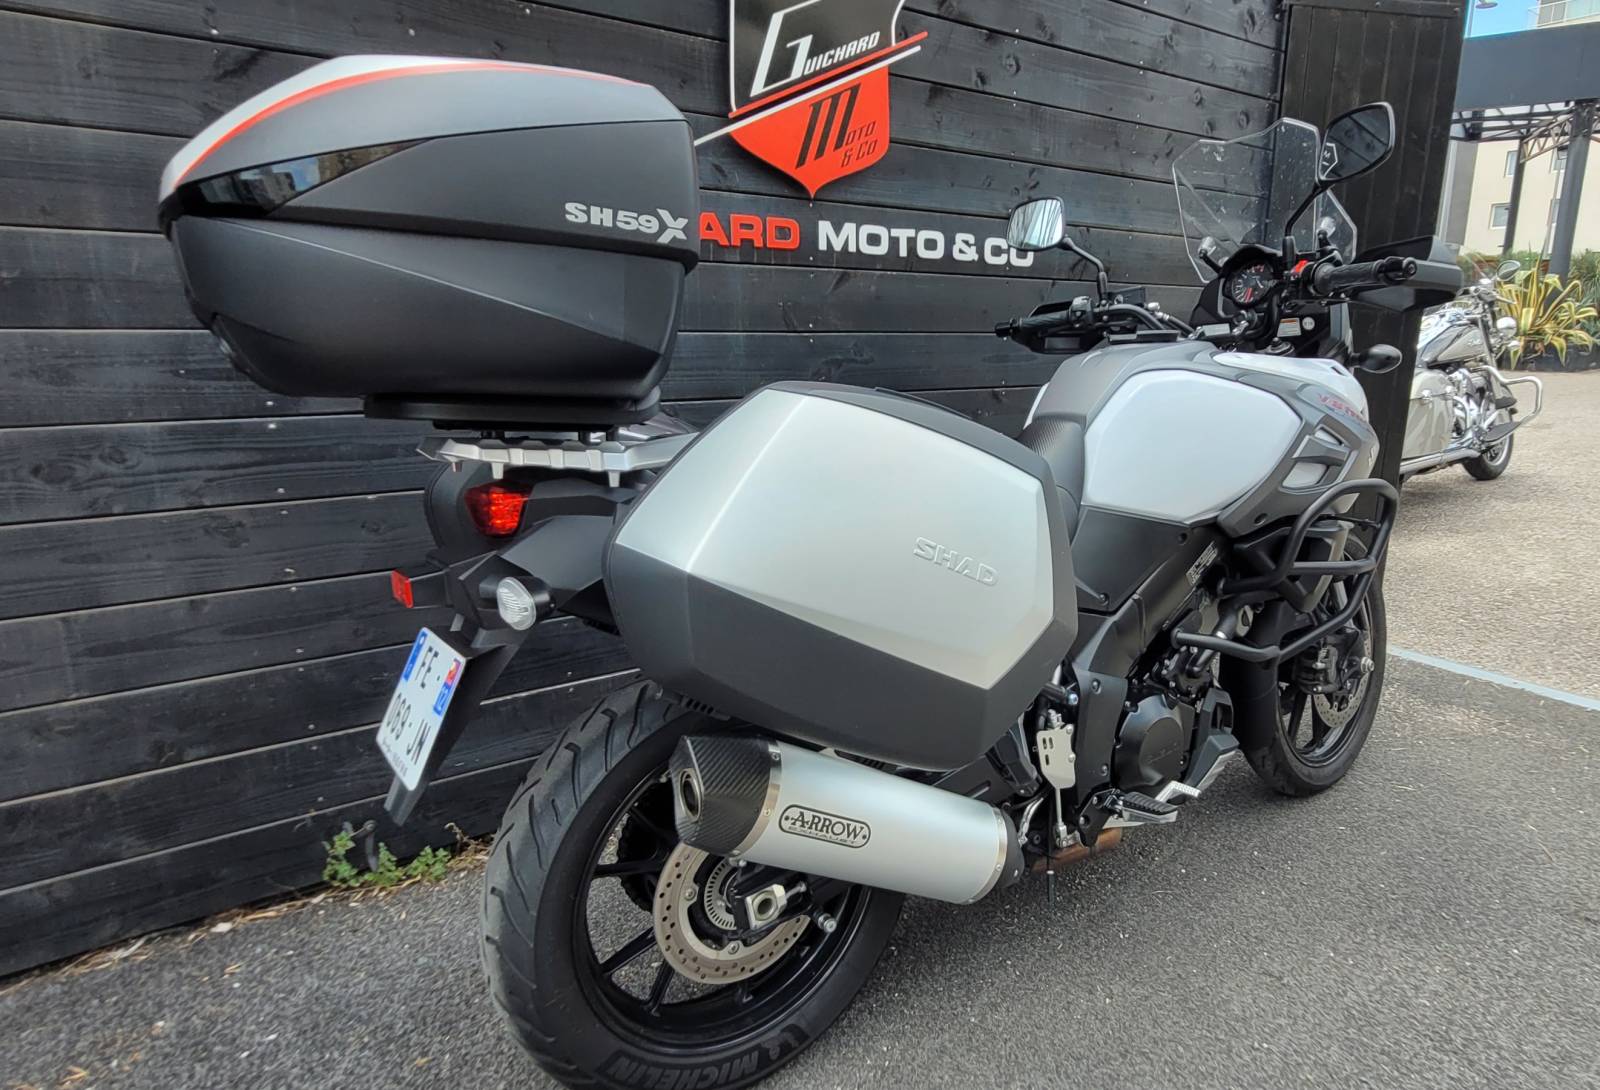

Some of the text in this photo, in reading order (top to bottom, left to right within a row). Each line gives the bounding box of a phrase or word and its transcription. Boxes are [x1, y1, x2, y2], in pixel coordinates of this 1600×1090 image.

[913, 536, 999, 587] SHAD
[790, 810, 865, 841] ARROW
[606, 1052, 759, 1090] MICHELIN
